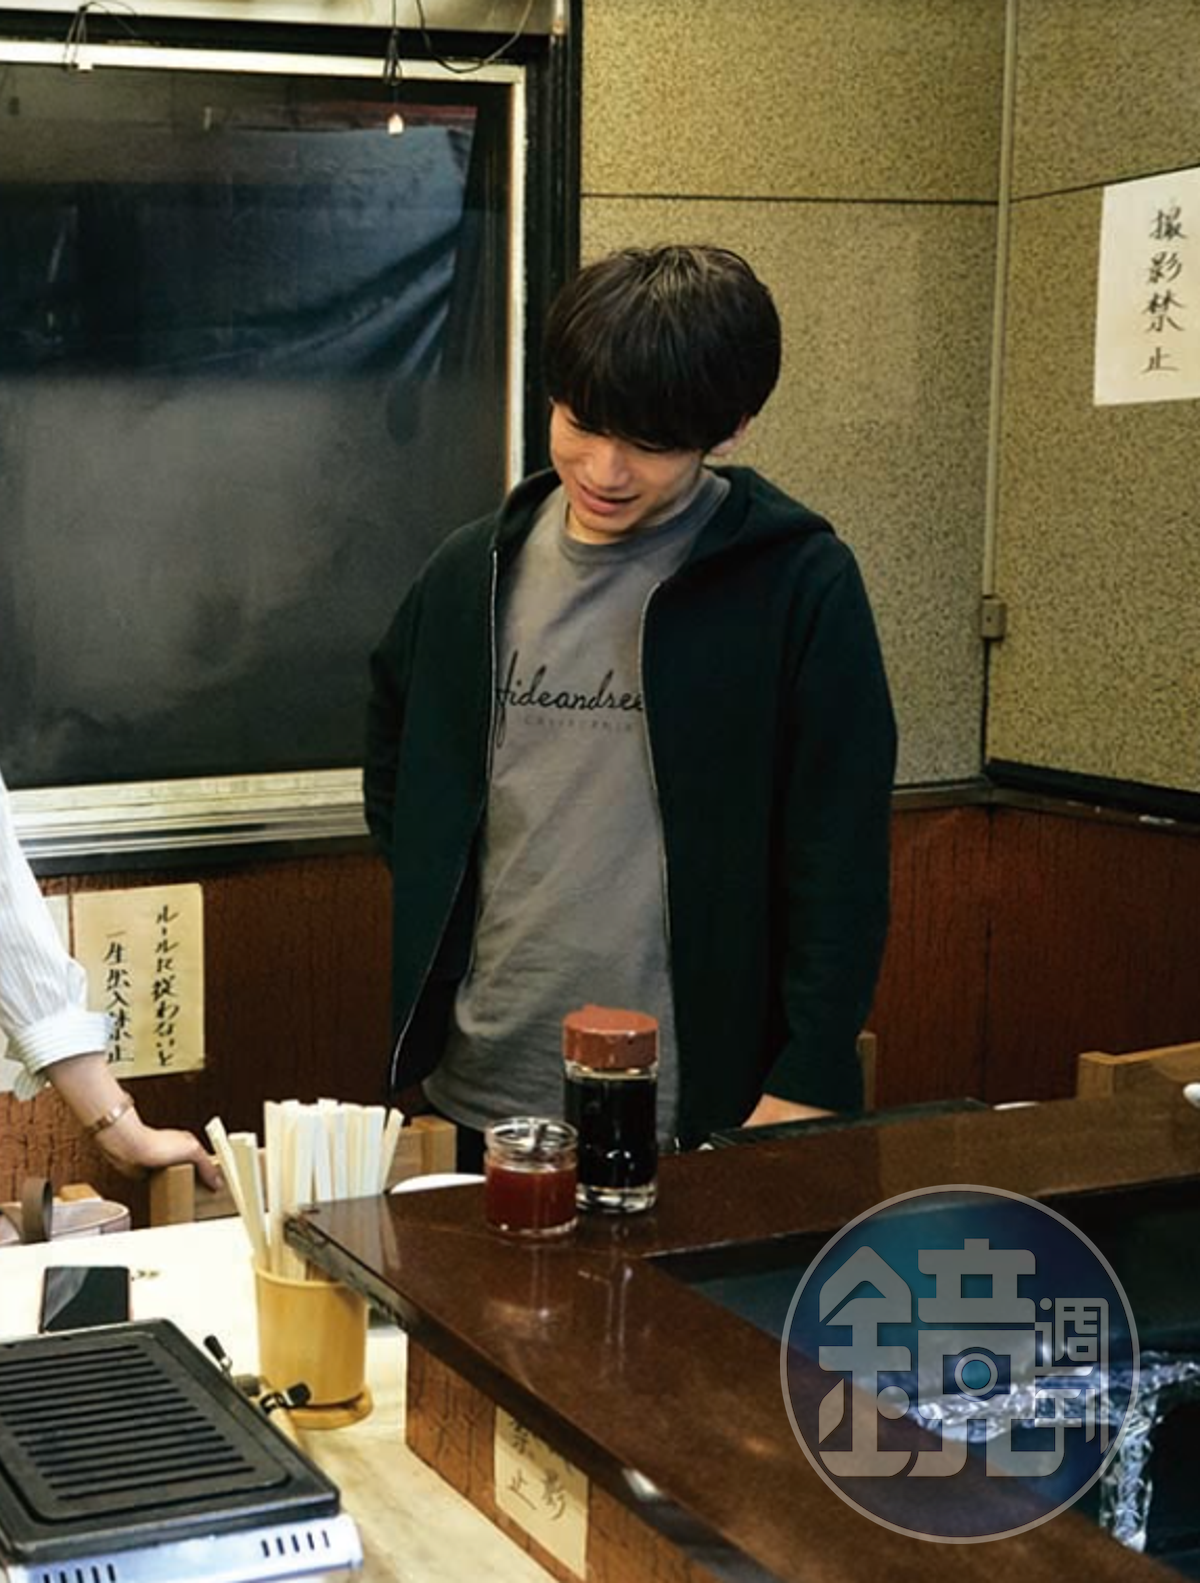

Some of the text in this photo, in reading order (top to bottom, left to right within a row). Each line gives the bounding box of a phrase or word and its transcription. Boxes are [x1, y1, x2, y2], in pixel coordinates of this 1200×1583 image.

[1141, 206, 1188, 374] 撮影禁止
[152, 904, 180, 1067] ルールに従わないと
